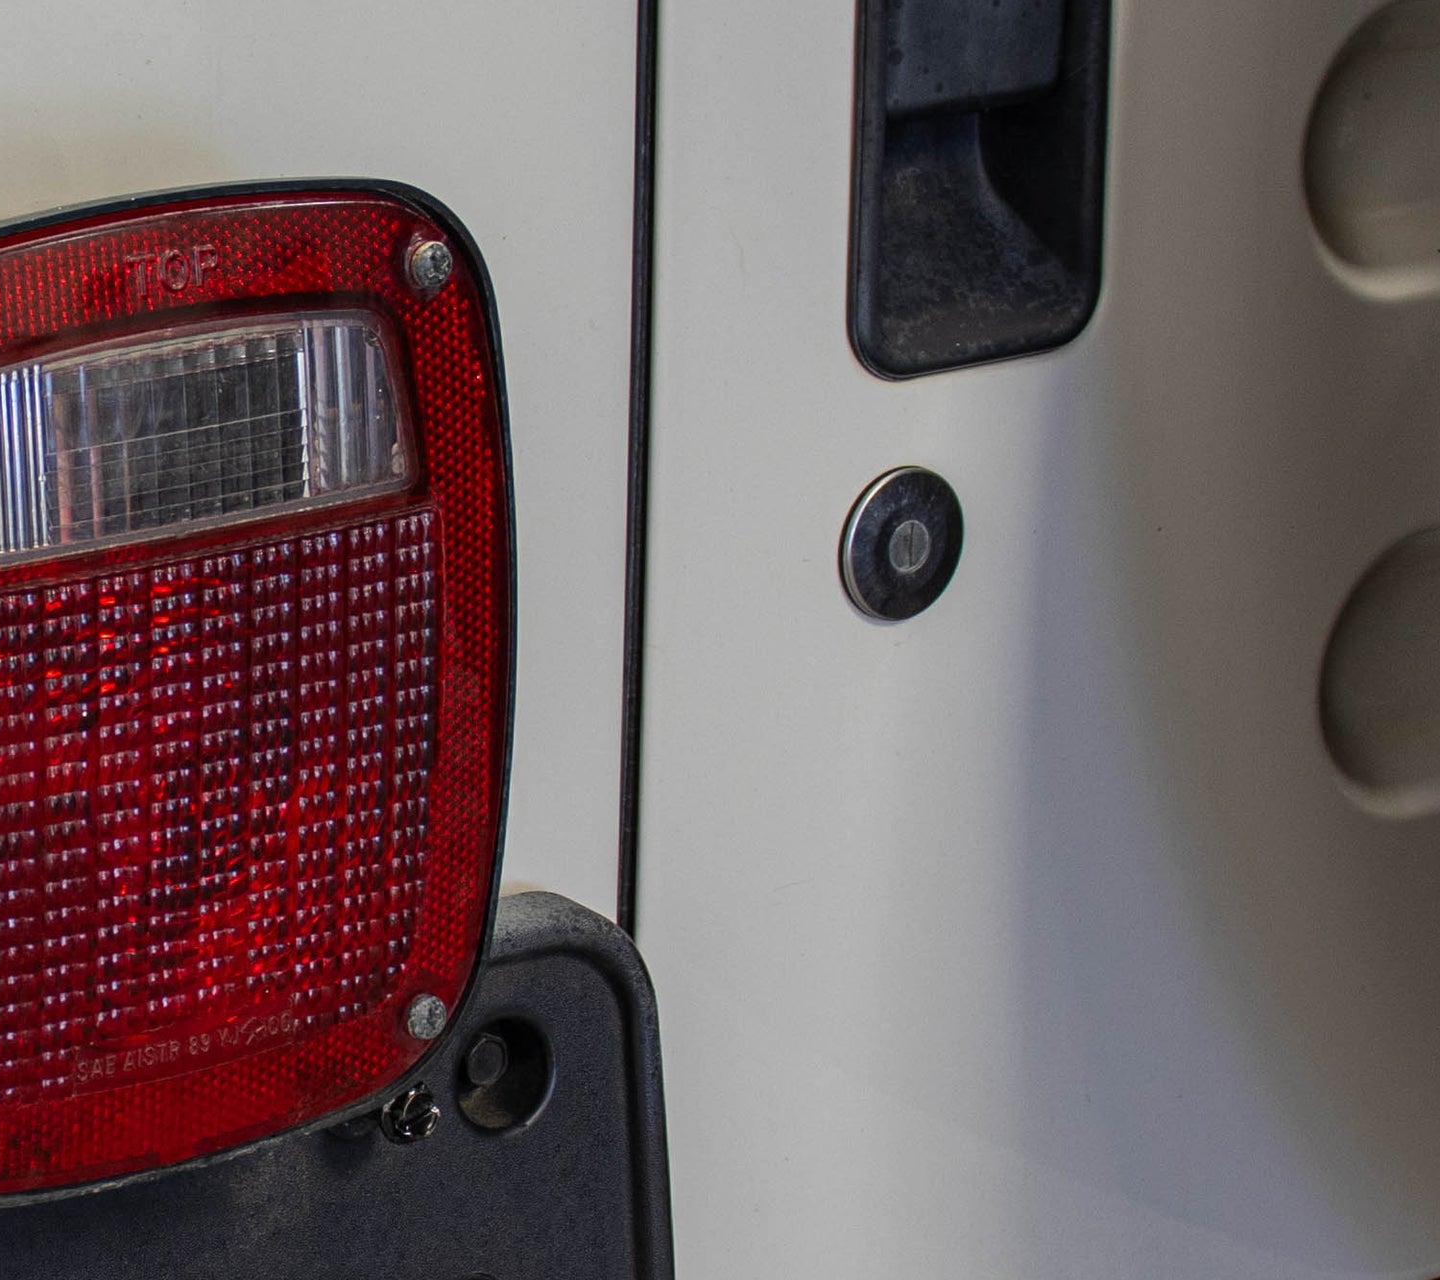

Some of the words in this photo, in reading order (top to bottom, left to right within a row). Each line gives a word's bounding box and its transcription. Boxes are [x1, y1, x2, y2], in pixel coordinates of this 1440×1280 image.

[123, 243, 219, 296] TOP
[76, 1054, 117, 1082] SAE
[188, 1033, 211, 1055] 89
